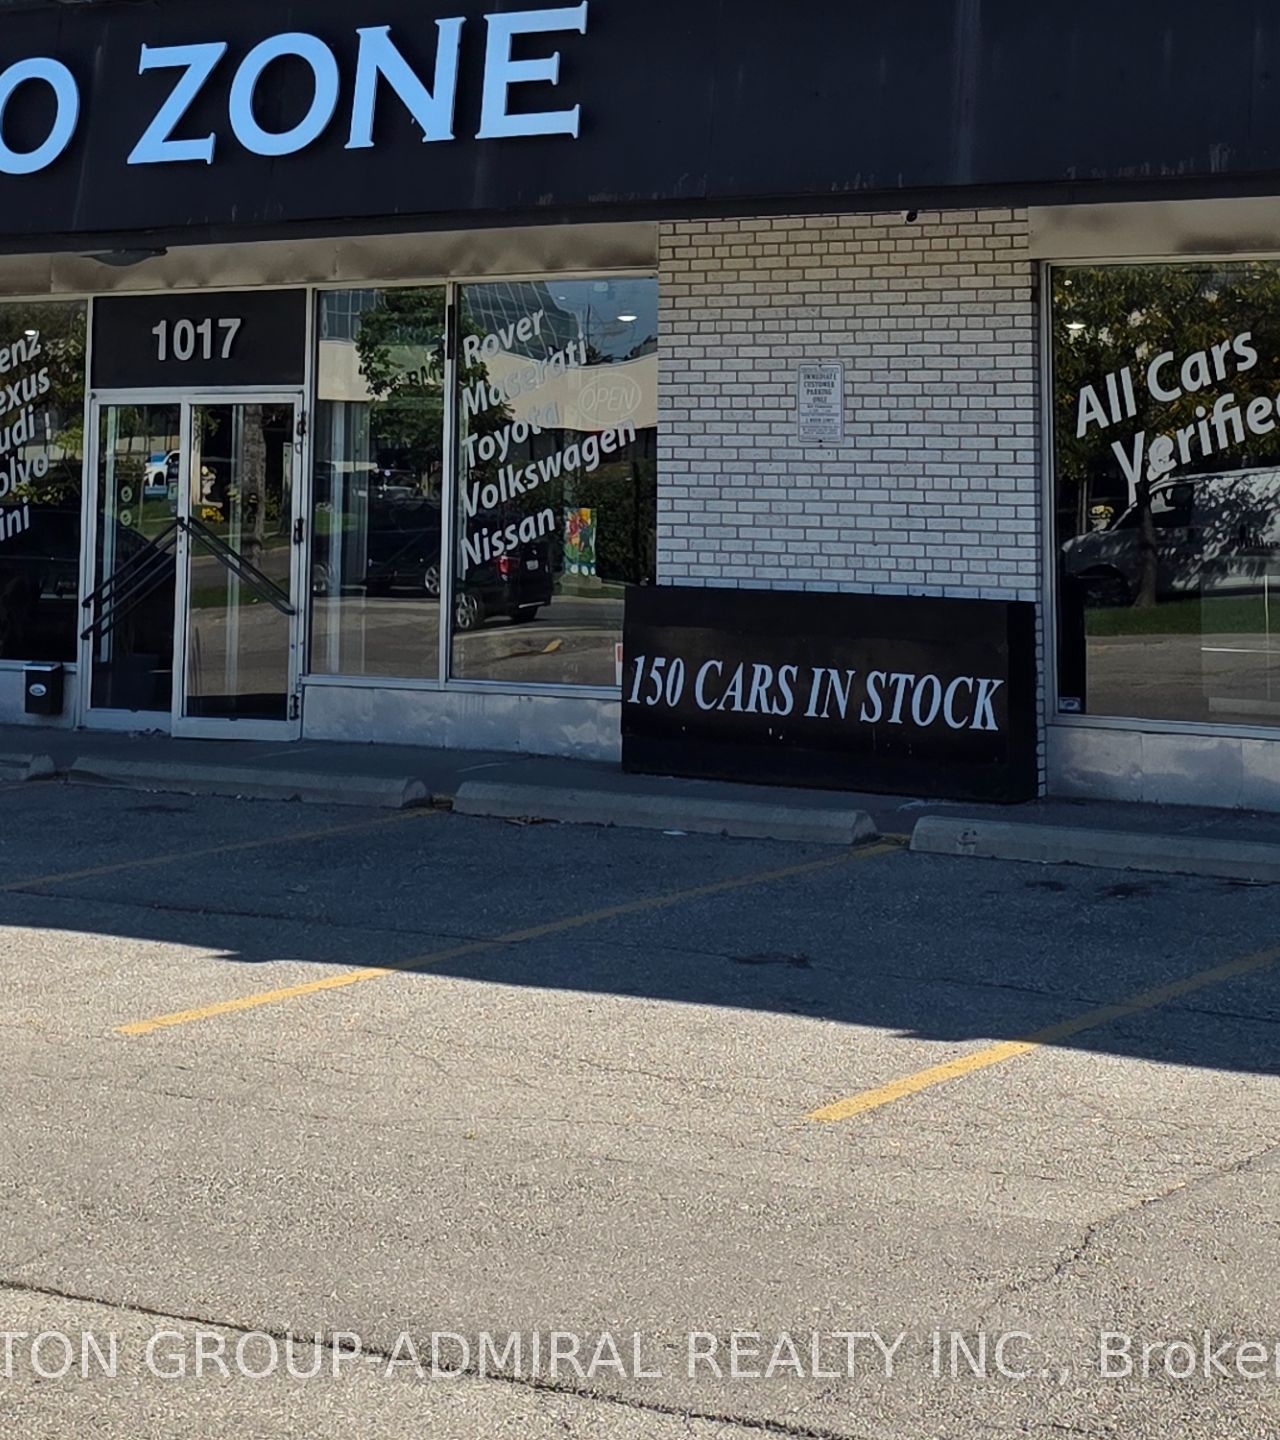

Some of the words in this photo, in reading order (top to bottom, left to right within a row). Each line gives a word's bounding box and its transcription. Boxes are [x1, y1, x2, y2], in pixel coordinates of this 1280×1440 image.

[126, 0, 589, 164] ZONE
[150, 317, 243, 362] 1017
[462, 309, 544, 369] Rover
[461, 330, 587, 420] Maserati
[581, 385, 635, 412] OPEN
[1075, 364, 1137, 439] All
[1146, 331, 1258, 404] Cars
[461, 401, 560, 468] Toyota
[461, 418, 636, 518] Volkswagen
[460, 507, 556, 570] Nissan
[627, 655, 685, 707] 150
[695, 660, 798, 717] CARS
[803, 667, 856, 720] IN
[860, 671, 1004, 731] STOCK
